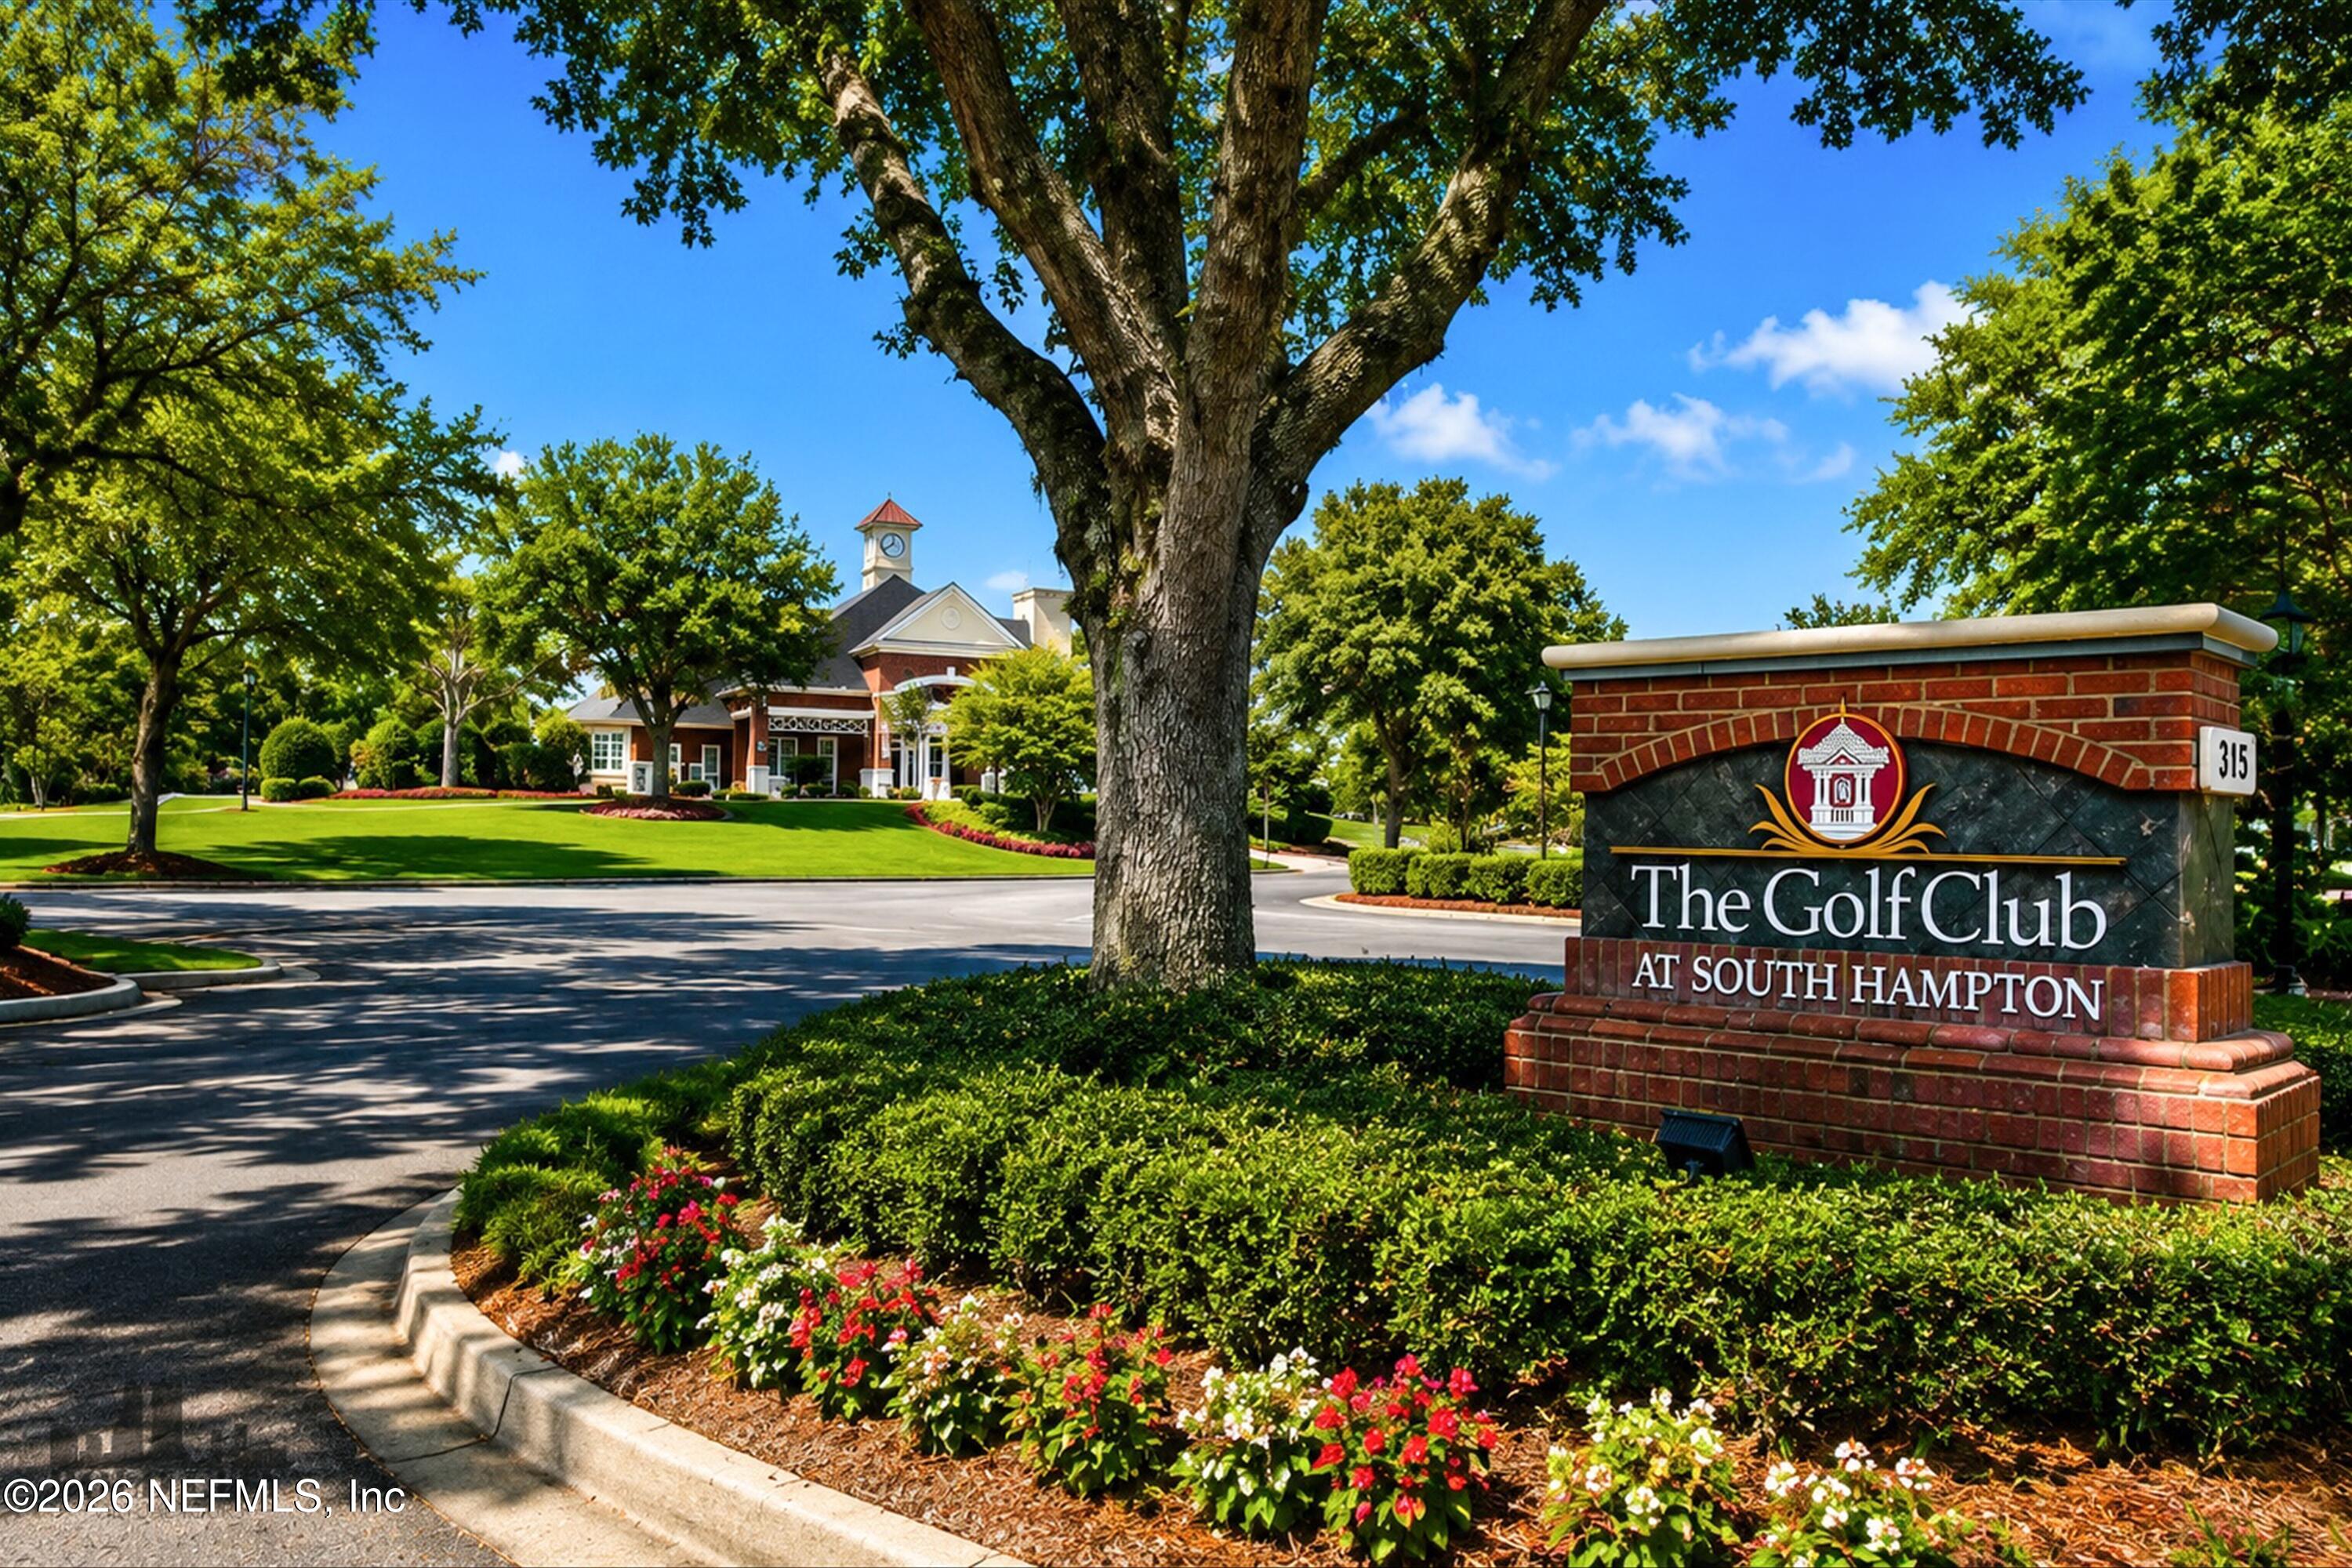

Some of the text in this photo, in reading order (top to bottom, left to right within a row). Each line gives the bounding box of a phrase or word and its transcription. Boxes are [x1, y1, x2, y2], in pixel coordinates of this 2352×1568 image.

[2219, 739, 2249, 780] 315
[1631, 862, 2107, 950] The Golf Club
[1632, 953, 2104, 1021] AT SOUTH HAMPTON
